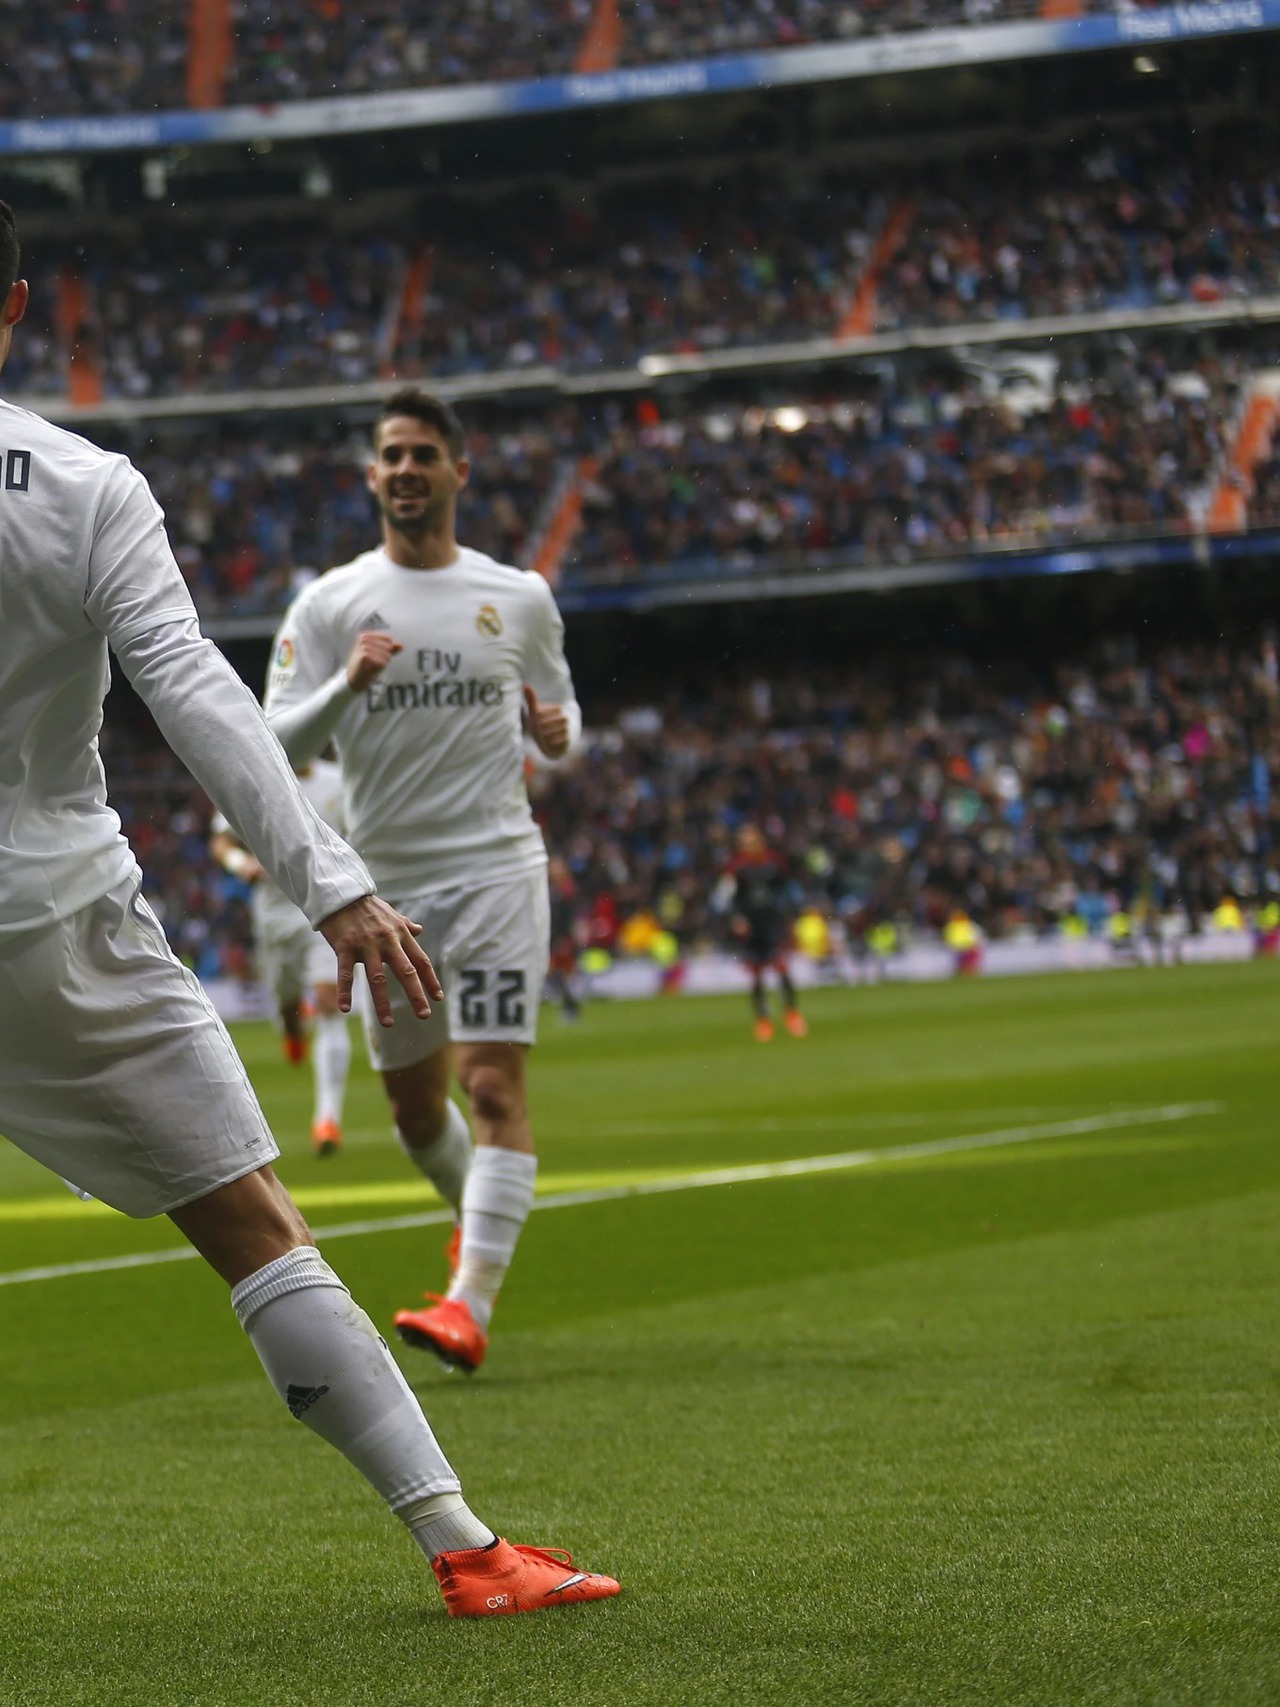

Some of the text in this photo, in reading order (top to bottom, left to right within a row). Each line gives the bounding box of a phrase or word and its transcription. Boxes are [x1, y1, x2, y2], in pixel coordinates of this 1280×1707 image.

[416, 647, 462, 674] Fly
[366, 674, 504, 713] Emirates
[460, 969, 525, 1027] 22
[486, 1594, 508, 1610] CR7
